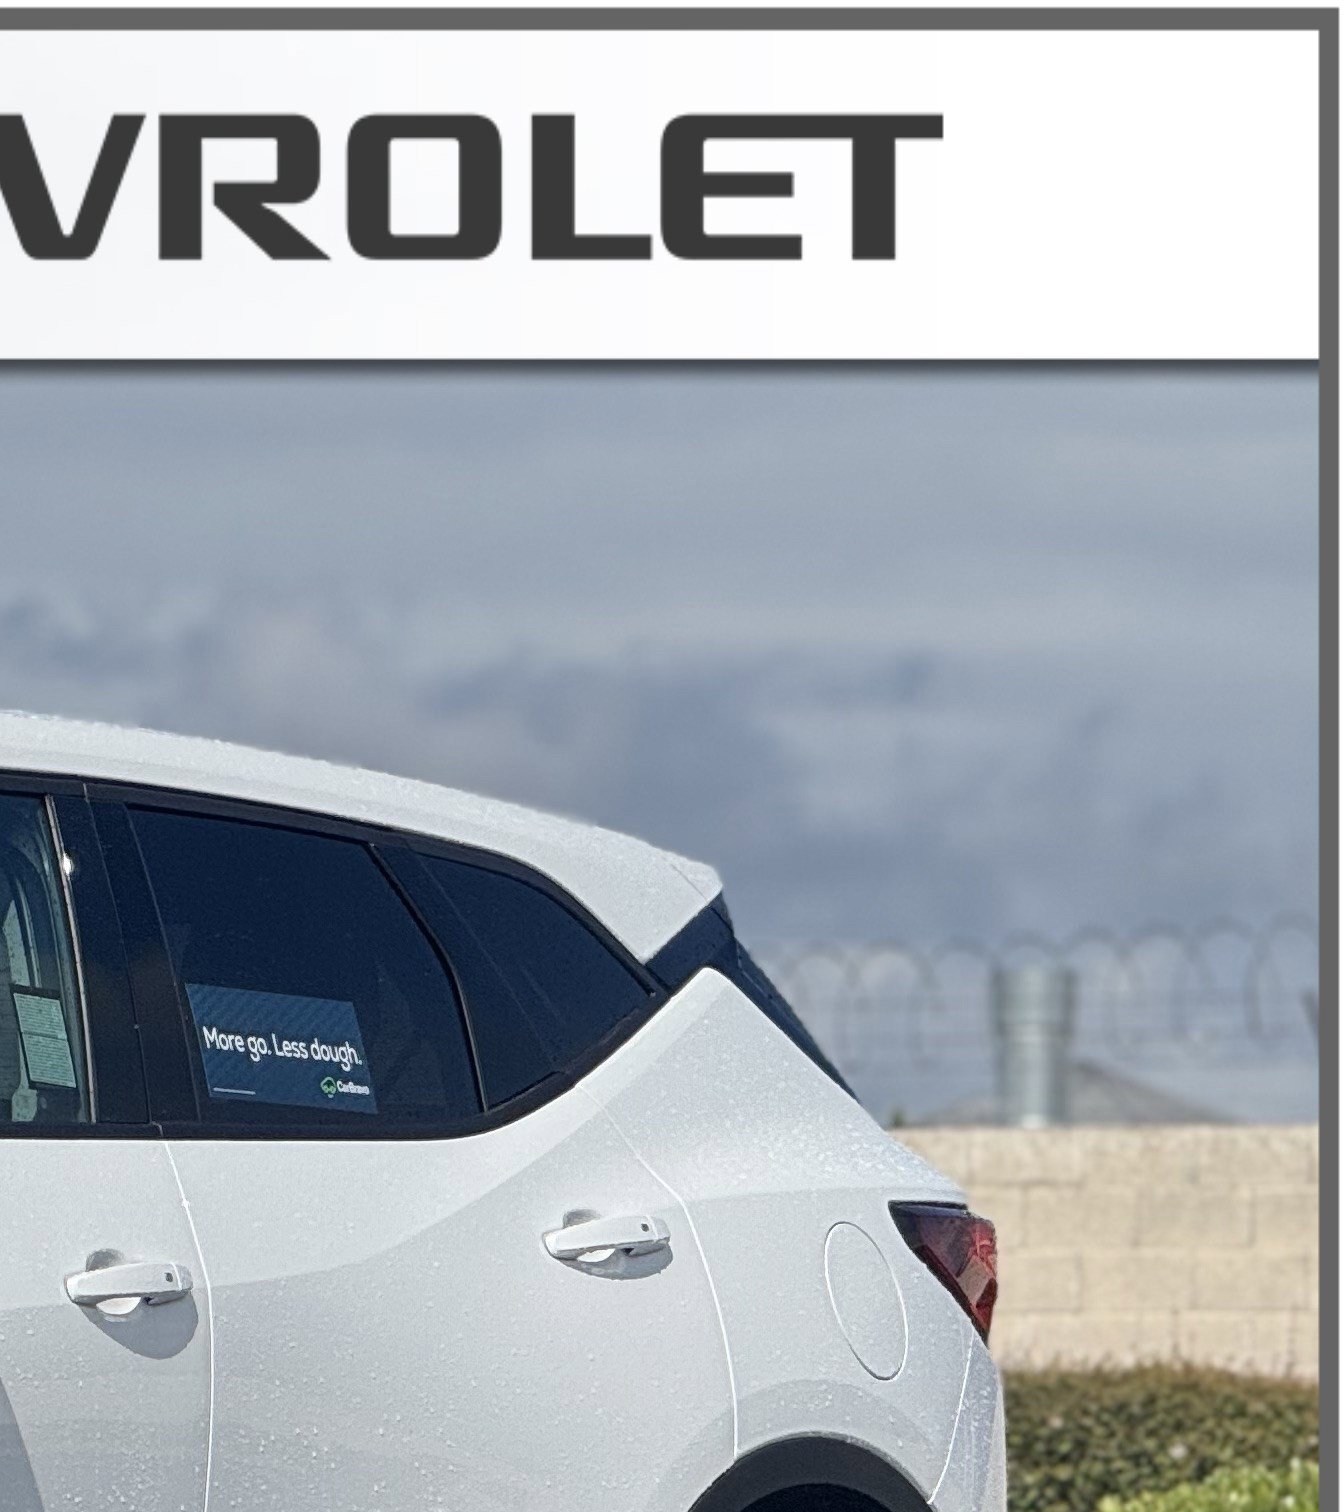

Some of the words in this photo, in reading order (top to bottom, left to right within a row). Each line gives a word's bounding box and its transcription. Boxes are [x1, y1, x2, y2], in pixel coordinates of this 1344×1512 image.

[202, 1026, 245, 1053] More
[247, 1035, 272, 1062] go.
[272, 1033, 308, 1059] Less
[311, 1038, 363, 1072] dough.
